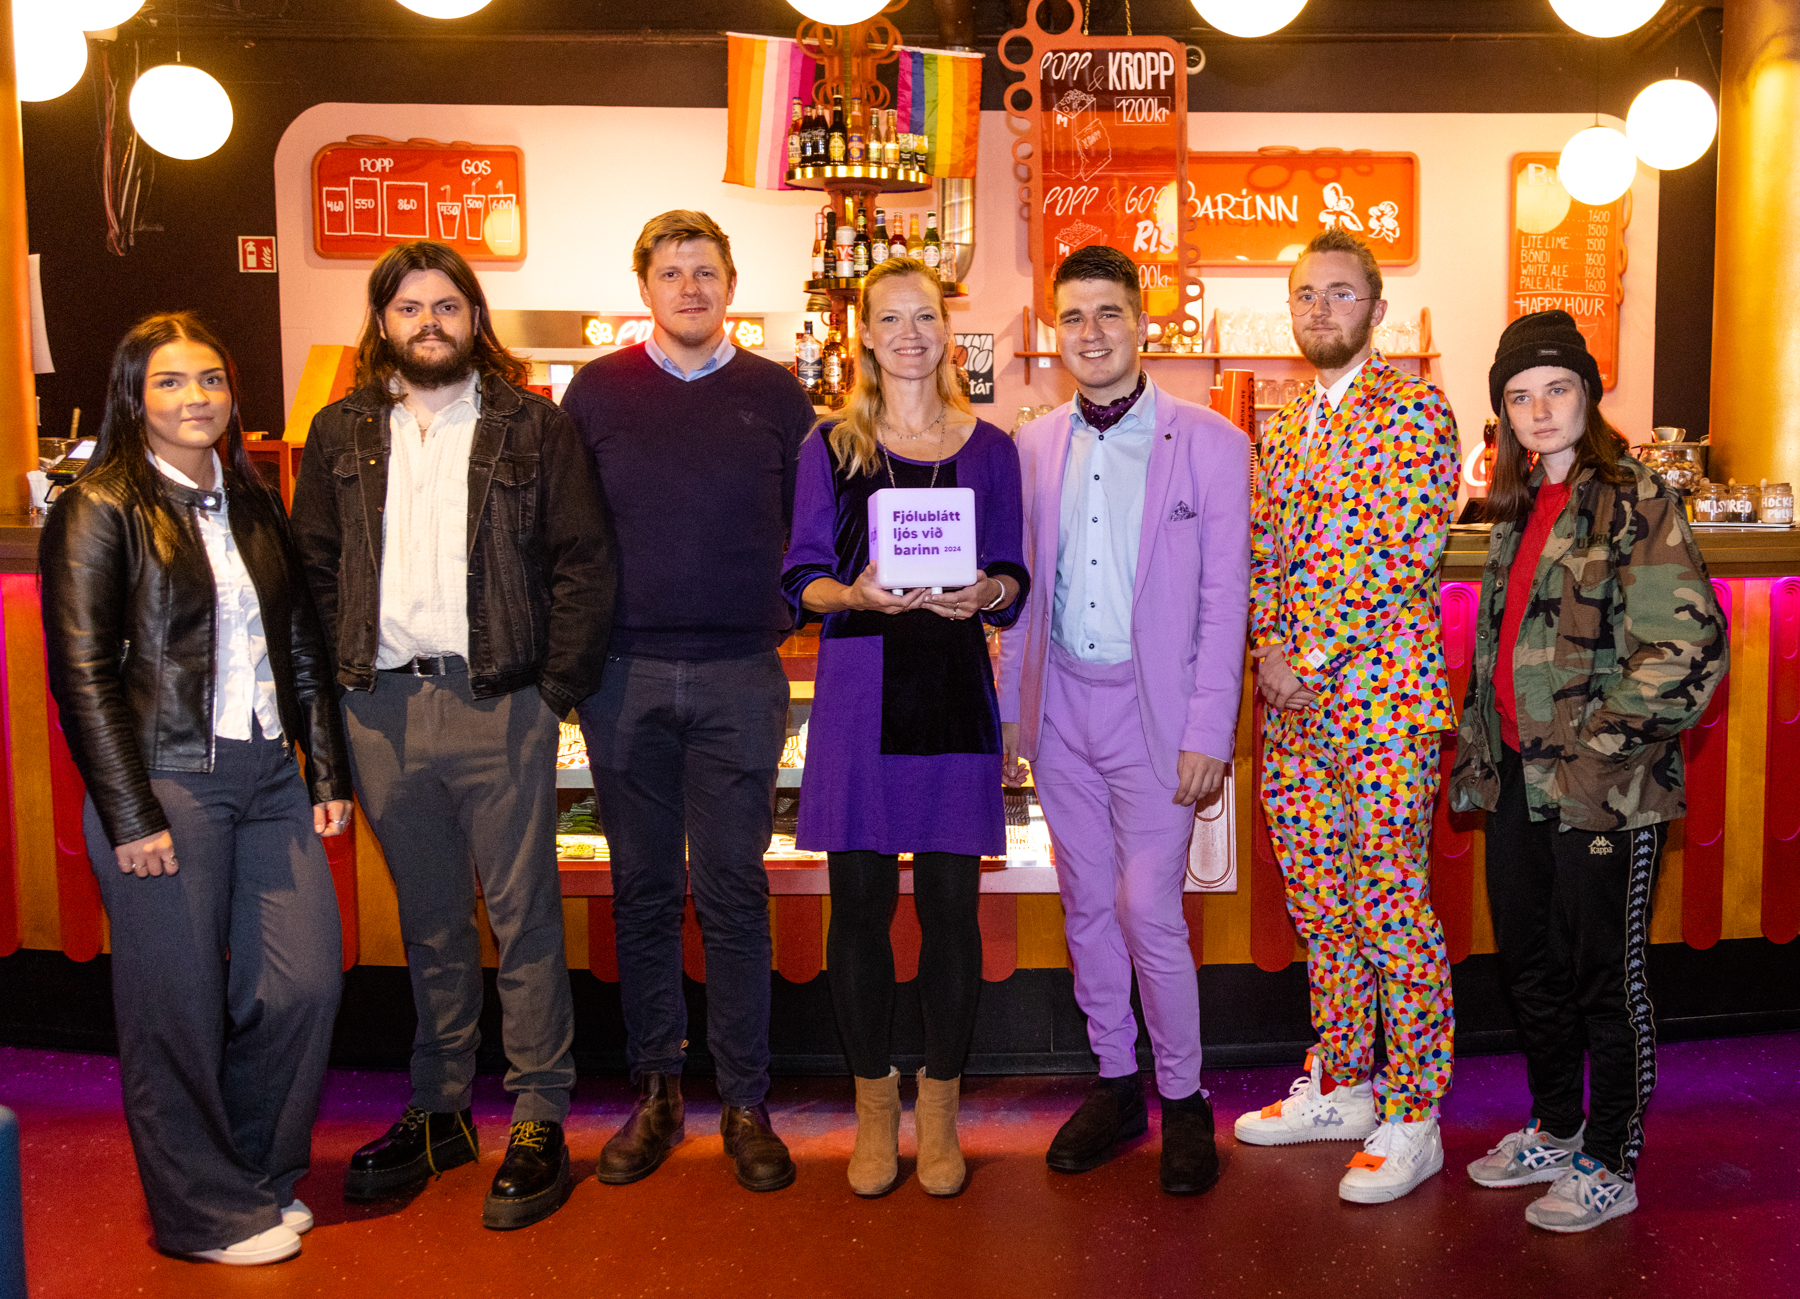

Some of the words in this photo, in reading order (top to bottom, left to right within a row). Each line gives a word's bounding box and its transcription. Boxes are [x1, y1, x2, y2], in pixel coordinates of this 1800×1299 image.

[1040, 51, 1092, 80] POPP
[1087, 65, 1105, 92] &
[1108, 51, 1175, 90] KROPP
[1116, 98, 1169, 123] 1200kr
[360, 157, 394, 172] POPP
[461, 158, 491, 175] GOS
[1527, 163, 1561, 186] BJ
[327, 200, 344, 212] 460
[354, 198, 375, 209] 550
[397, 198, 417, 210] 860
[466, 198, 482, 209] 500
[492, 199, 512, 210] 600
[1043, 185, 1099, 216] POPP
[1588, 209, 1611, 223] 1600
[1587, 223, 1608, 237] 1500
[1521, 235, 1544, 249] LITE
[1545, 236, 1570, 249] LIME
[1585, 238, 1606, 252] 1500
[1585, 252, 1606, 267] 1600
[1138, 264, 1172, 289] 00kr
[1520, 264, 1549, 276] WHITE
[1550, 265, 1569, 277] ALE
[1584, 265, 1606, 279] 1600
[1519, 276, 1543, 290] PALE
[1544, 277, 1564, 291] ALE
[1585, 279, 1607, 293] 1600
[1519, 296, 1562, 315] HAPPY
[1564, 296, 1606, 316] HOUR
[969, 378, 994, 395] tár
[893, 511, 961, 524] Fjólublátt
[893, 527, 918, 541] ljós
[921, 527, 943, 539] við
[894, 544, 940, 555] barinn
[1590, 847, 1613, 855] Kappa
